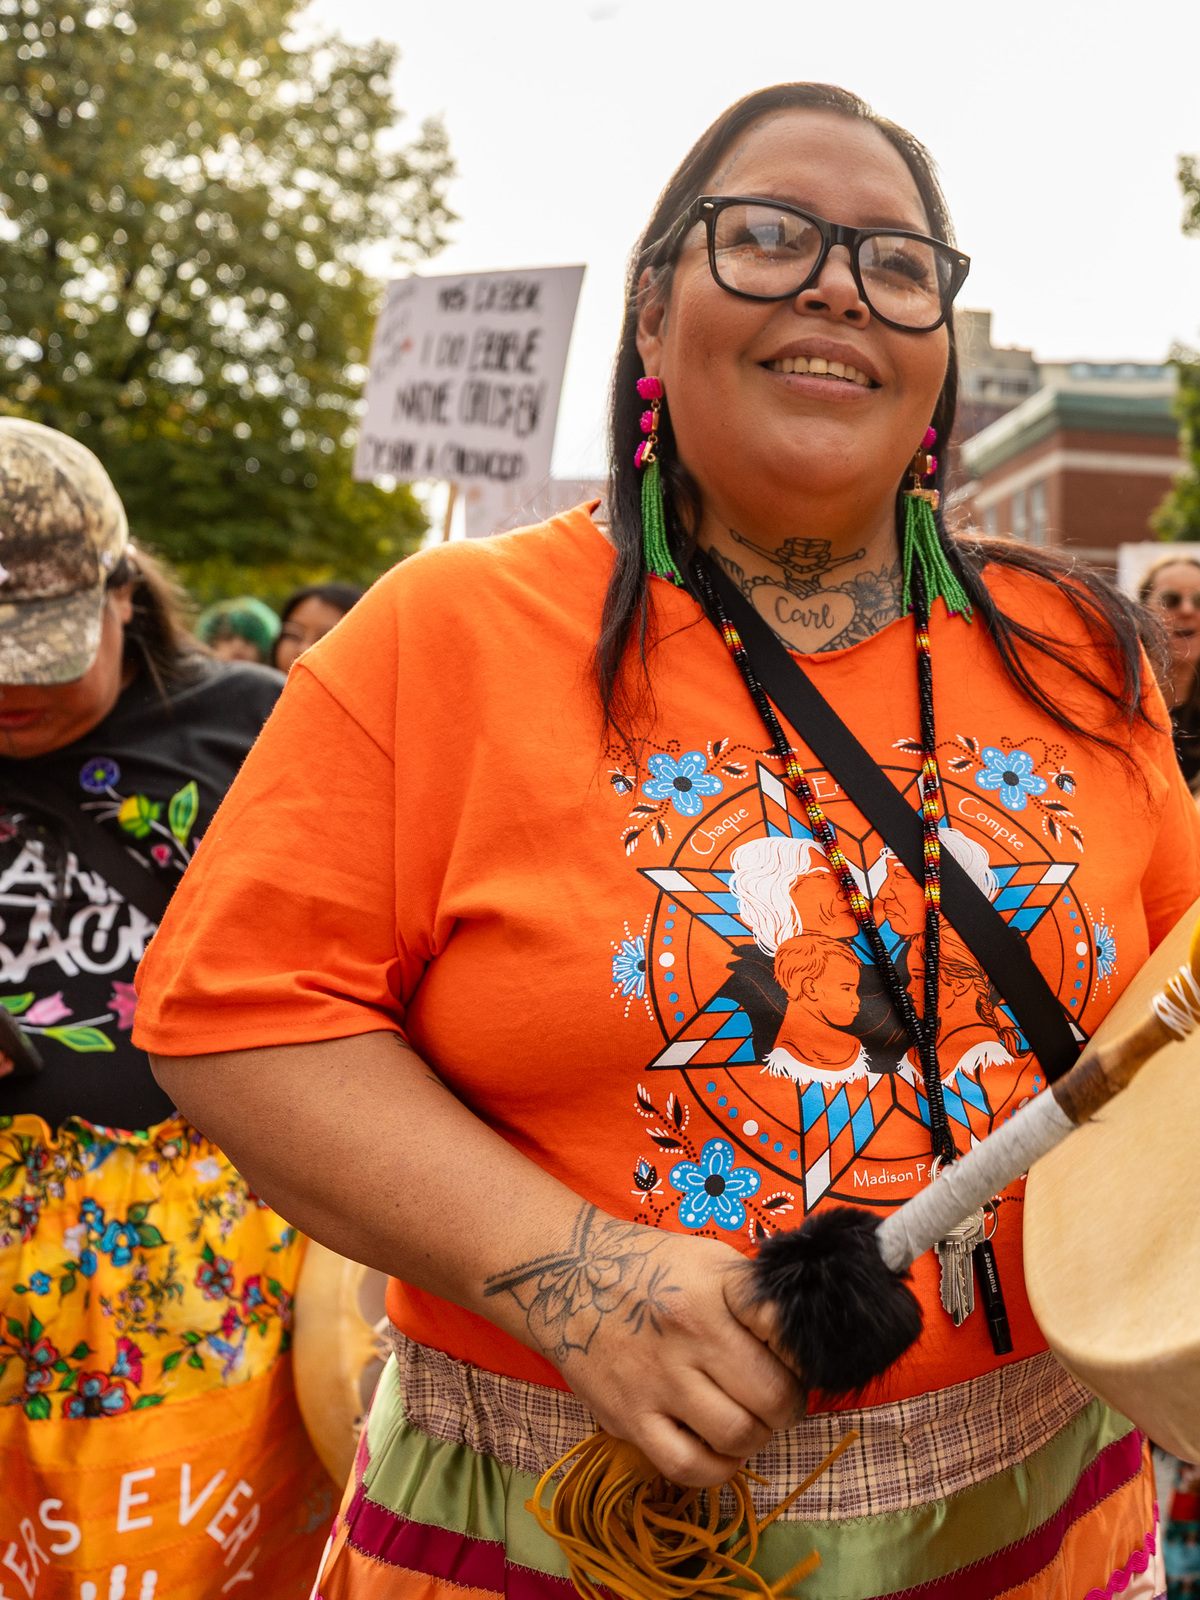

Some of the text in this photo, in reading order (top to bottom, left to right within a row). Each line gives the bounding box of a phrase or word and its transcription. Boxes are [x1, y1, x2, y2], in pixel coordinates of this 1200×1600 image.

[774, 596, 835, 630] Carl
[690, 808, 750, 855] Chaque
[958, 797, 1025, 851] Compte
[853, 1168, 914, 1188] Madison
[984, 1252, 998, 1293] munkees
[0, 1462, 261, 1600] ERS EVERY
